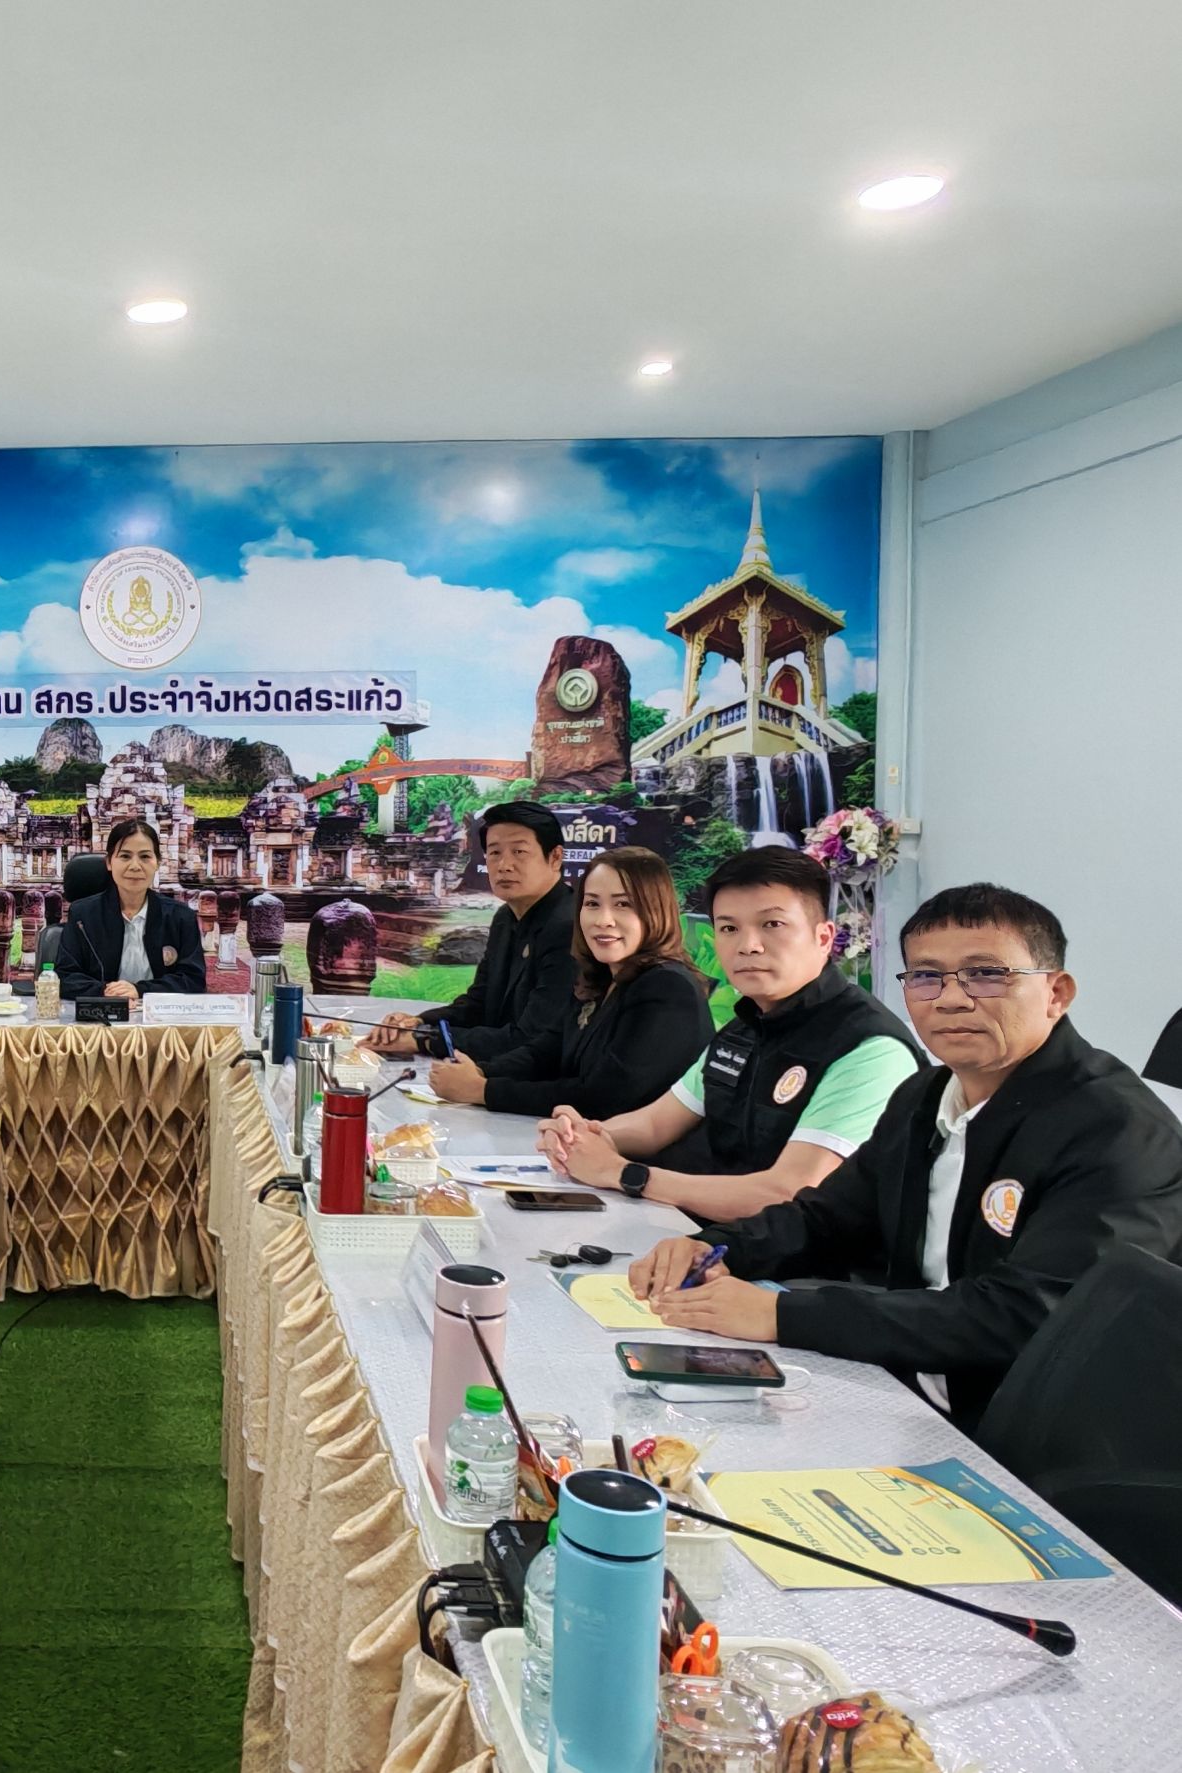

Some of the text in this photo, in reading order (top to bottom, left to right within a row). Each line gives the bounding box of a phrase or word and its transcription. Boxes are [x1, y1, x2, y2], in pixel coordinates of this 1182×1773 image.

[34, 678, 403, 715] สกร.ประจำจังหวัดสระแก้ว
[561, 815, 616, 844] งสีดา
